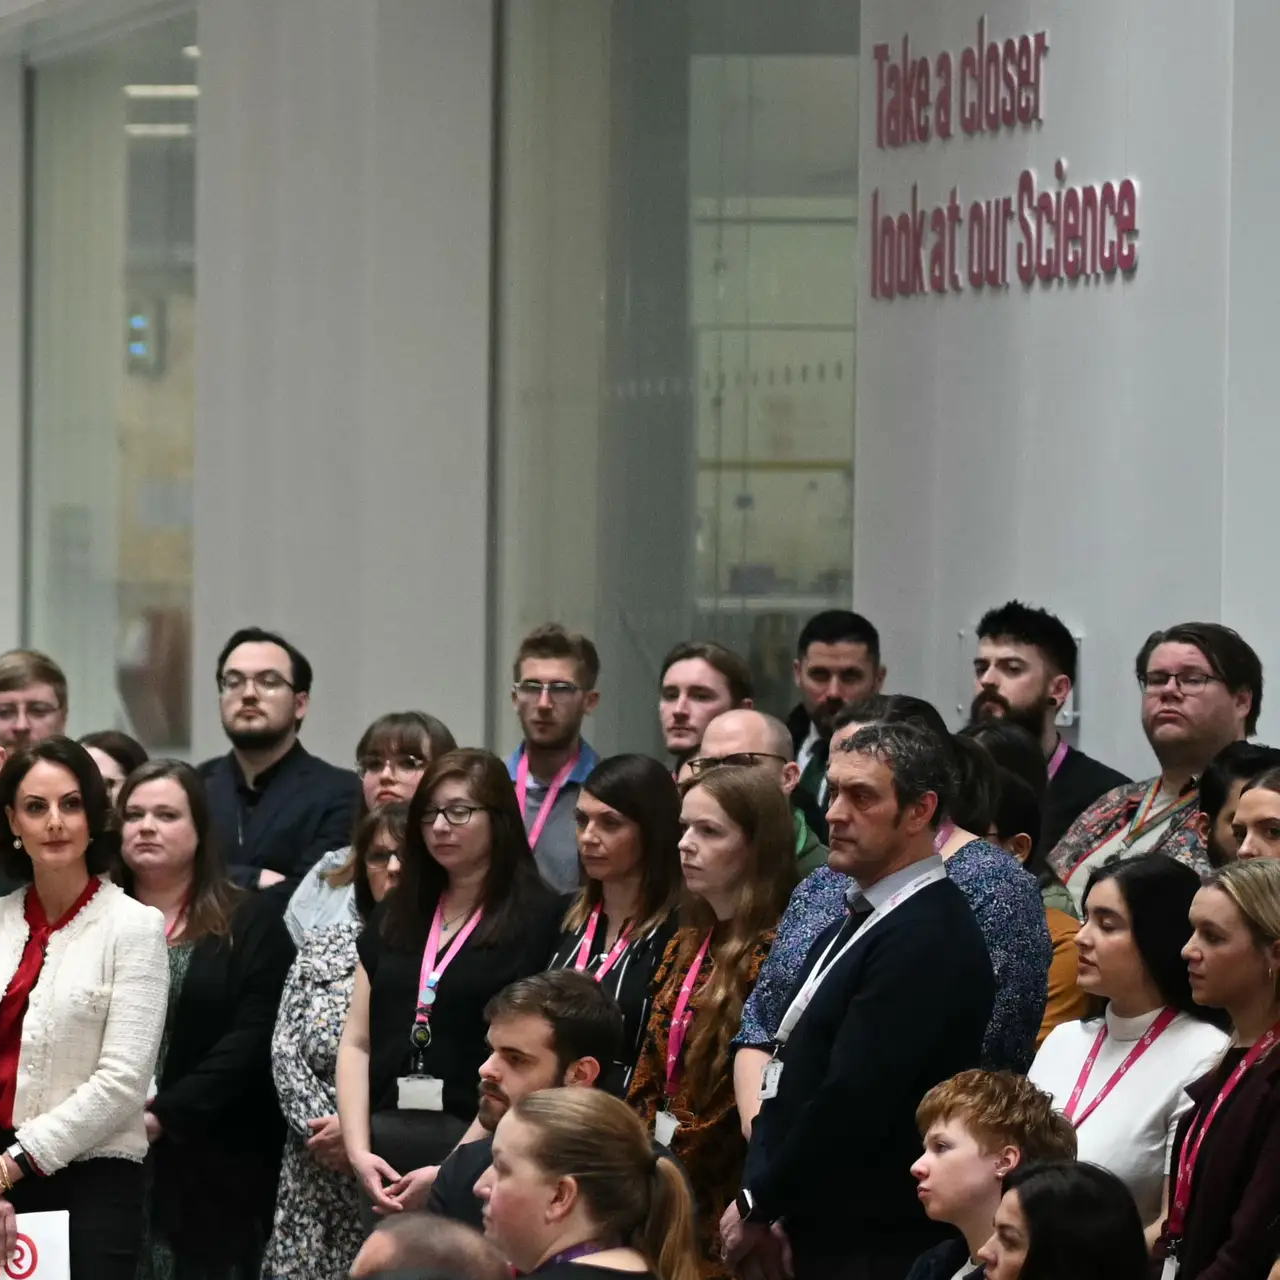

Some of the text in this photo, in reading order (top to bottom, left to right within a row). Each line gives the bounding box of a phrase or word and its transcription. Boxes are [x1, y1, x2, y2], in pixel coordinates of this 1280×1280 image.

[873, 13, 1049, 149] Take a closer
[871, 158, 1139, 299] look at our Science
